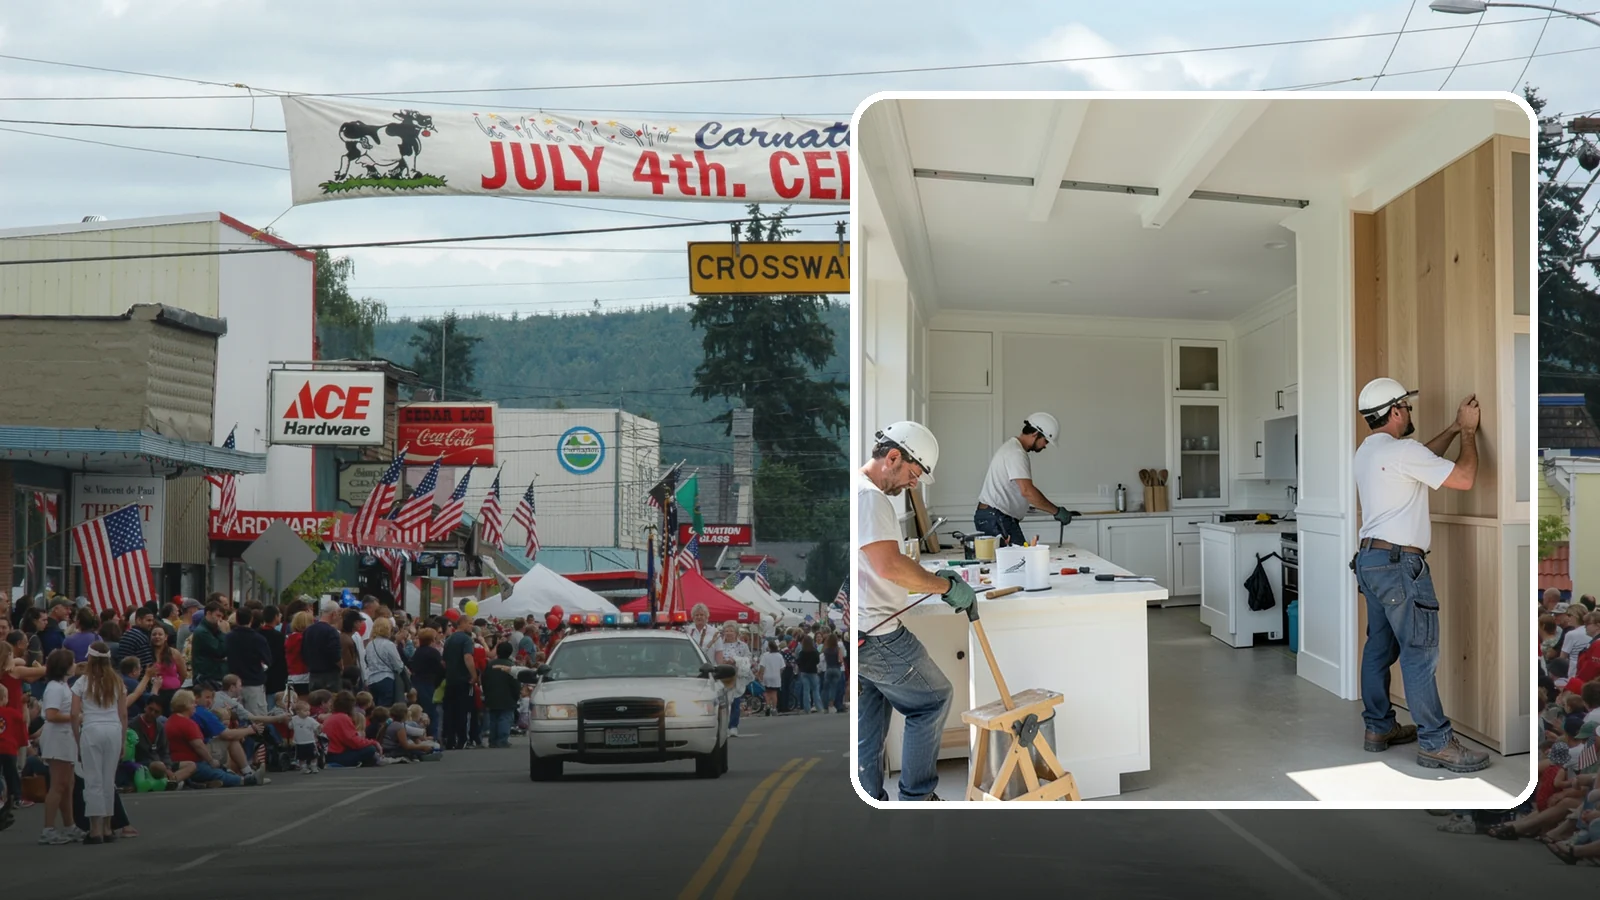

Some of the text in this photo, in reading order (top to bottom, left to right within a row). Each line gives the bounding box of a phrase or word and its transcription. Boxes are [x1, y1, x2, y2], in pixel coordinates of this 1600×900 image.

[481, 141, 604, 192] JULY
[632, 150, 746, 198] 4th.
[697, 254, 850, 280] CROSSWA
[283, 380, 373, 420] ACE
[405, 409, 453, 422] CEDAR
[283, 421, 371, 436] Hardware
[96, 485, 124, 494] Vincent
[126, 485, 136, 494] de
[137, 486, 155, 495] Paul
[688, 526, 741, 535] CRNATION
[699, 535, 730, 543] GLASS
